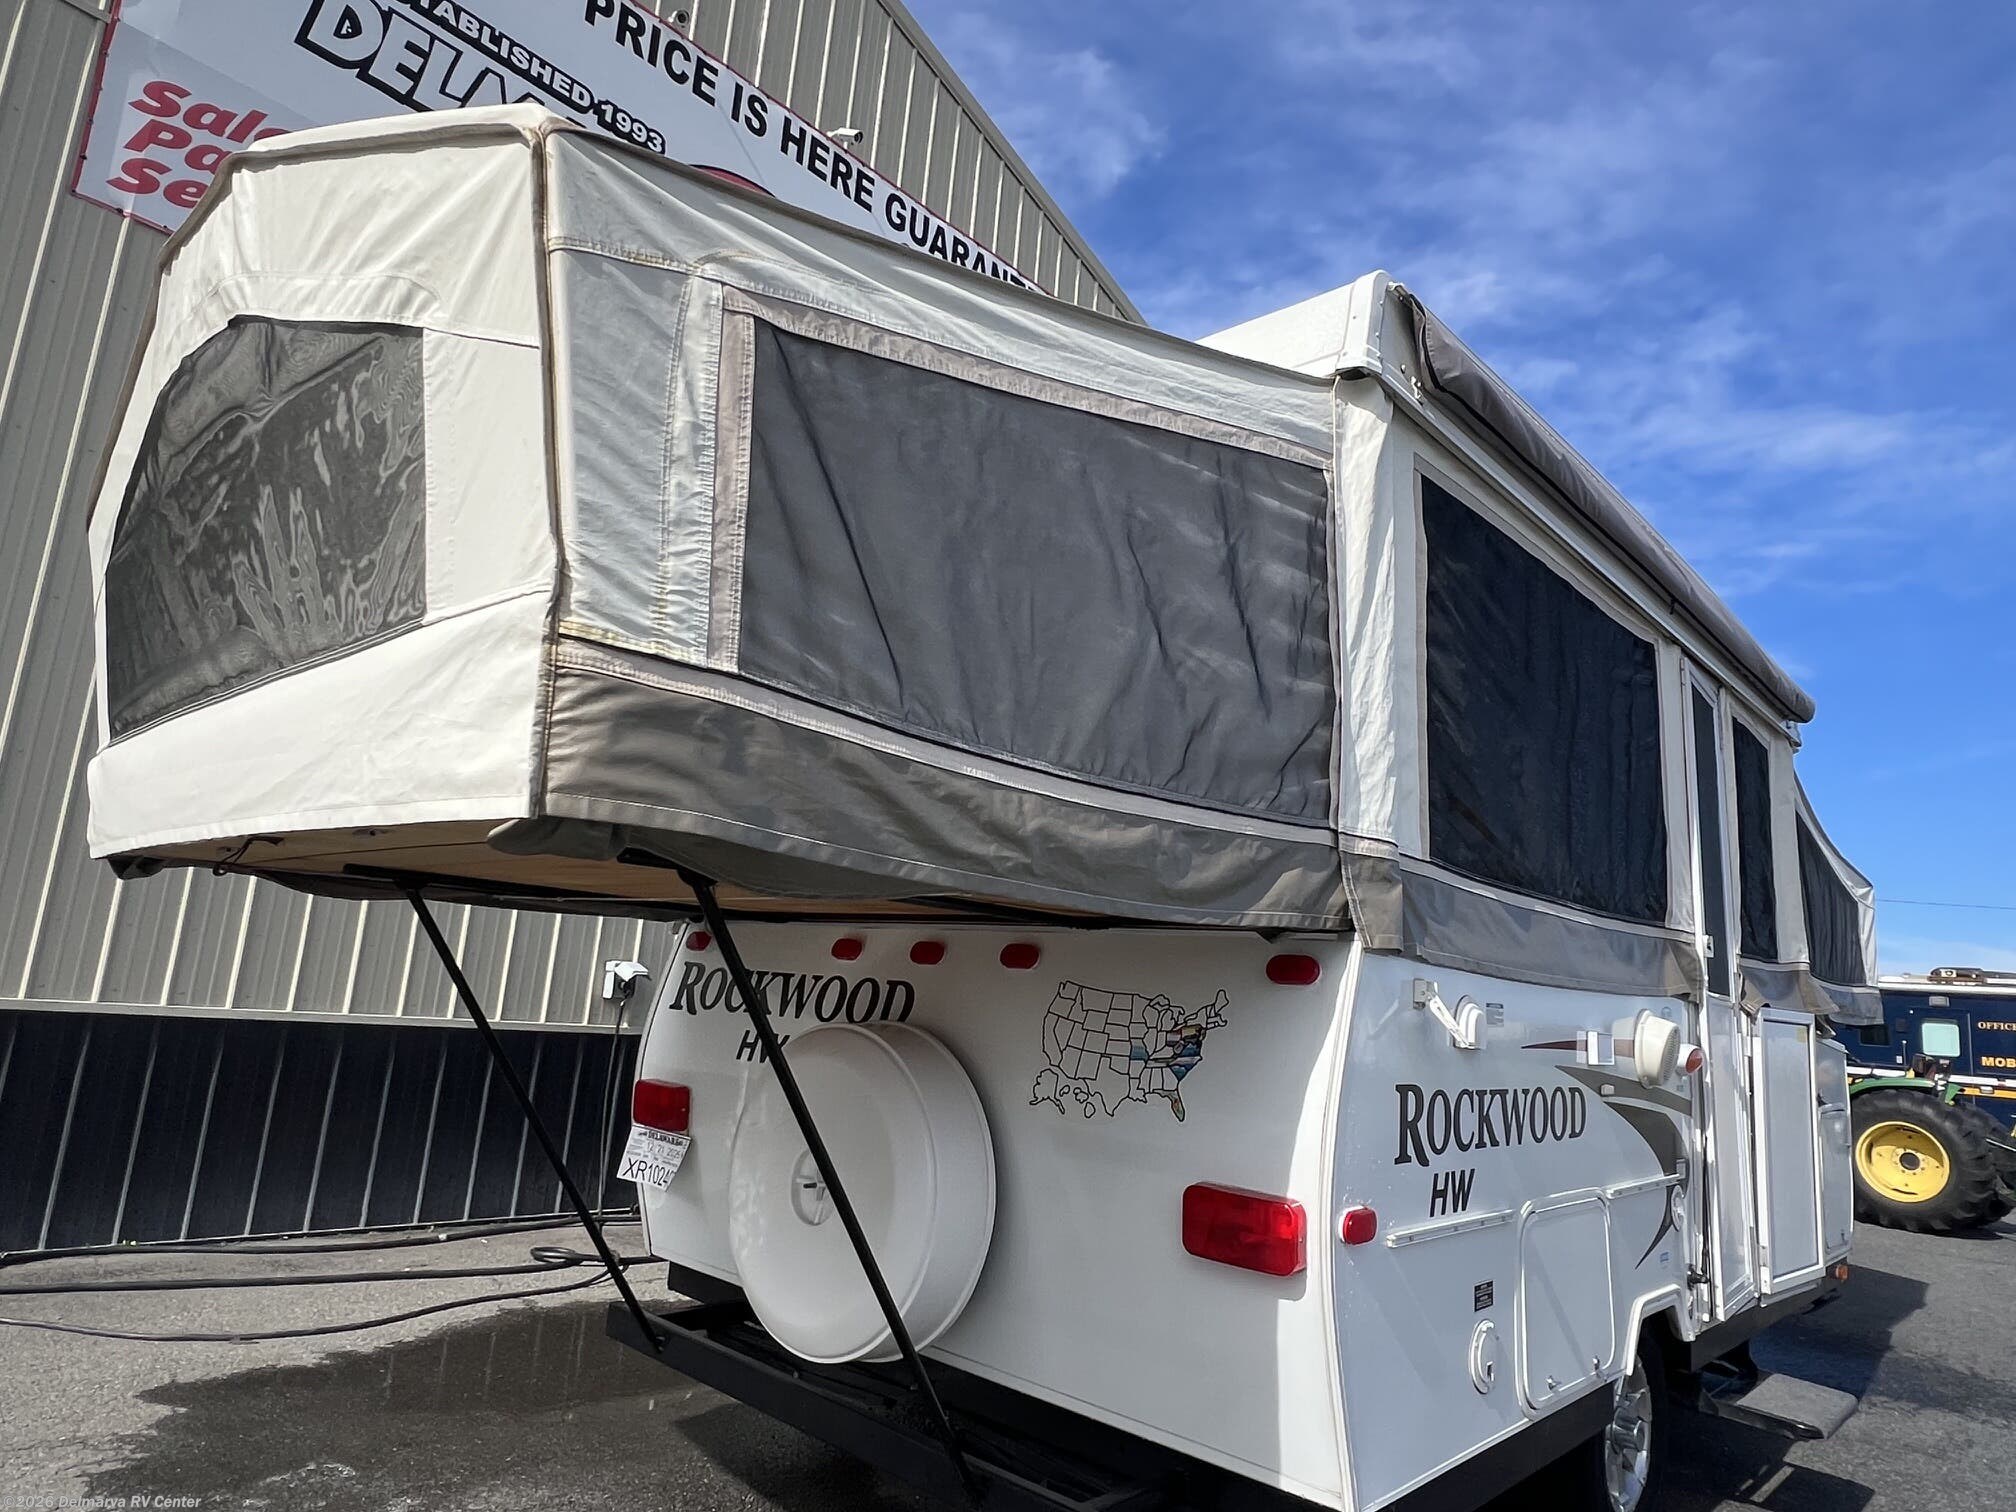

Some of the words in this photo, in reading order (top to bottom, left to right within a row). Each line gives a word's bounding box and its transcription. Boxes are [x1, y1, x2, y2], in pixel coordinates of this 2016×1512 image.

[585, 0, 719, 106] PRICE
[730, 82, 768, 137] IS
[780, 115, 875, 213] HERE
[600, 103, 664, 154] 1993
[1981, 1056, 2016, 1068] MOB
[1394, 1084, 1587, 1167] ROCKWOOD
[1429, 1168, 1475, 1218] HW
